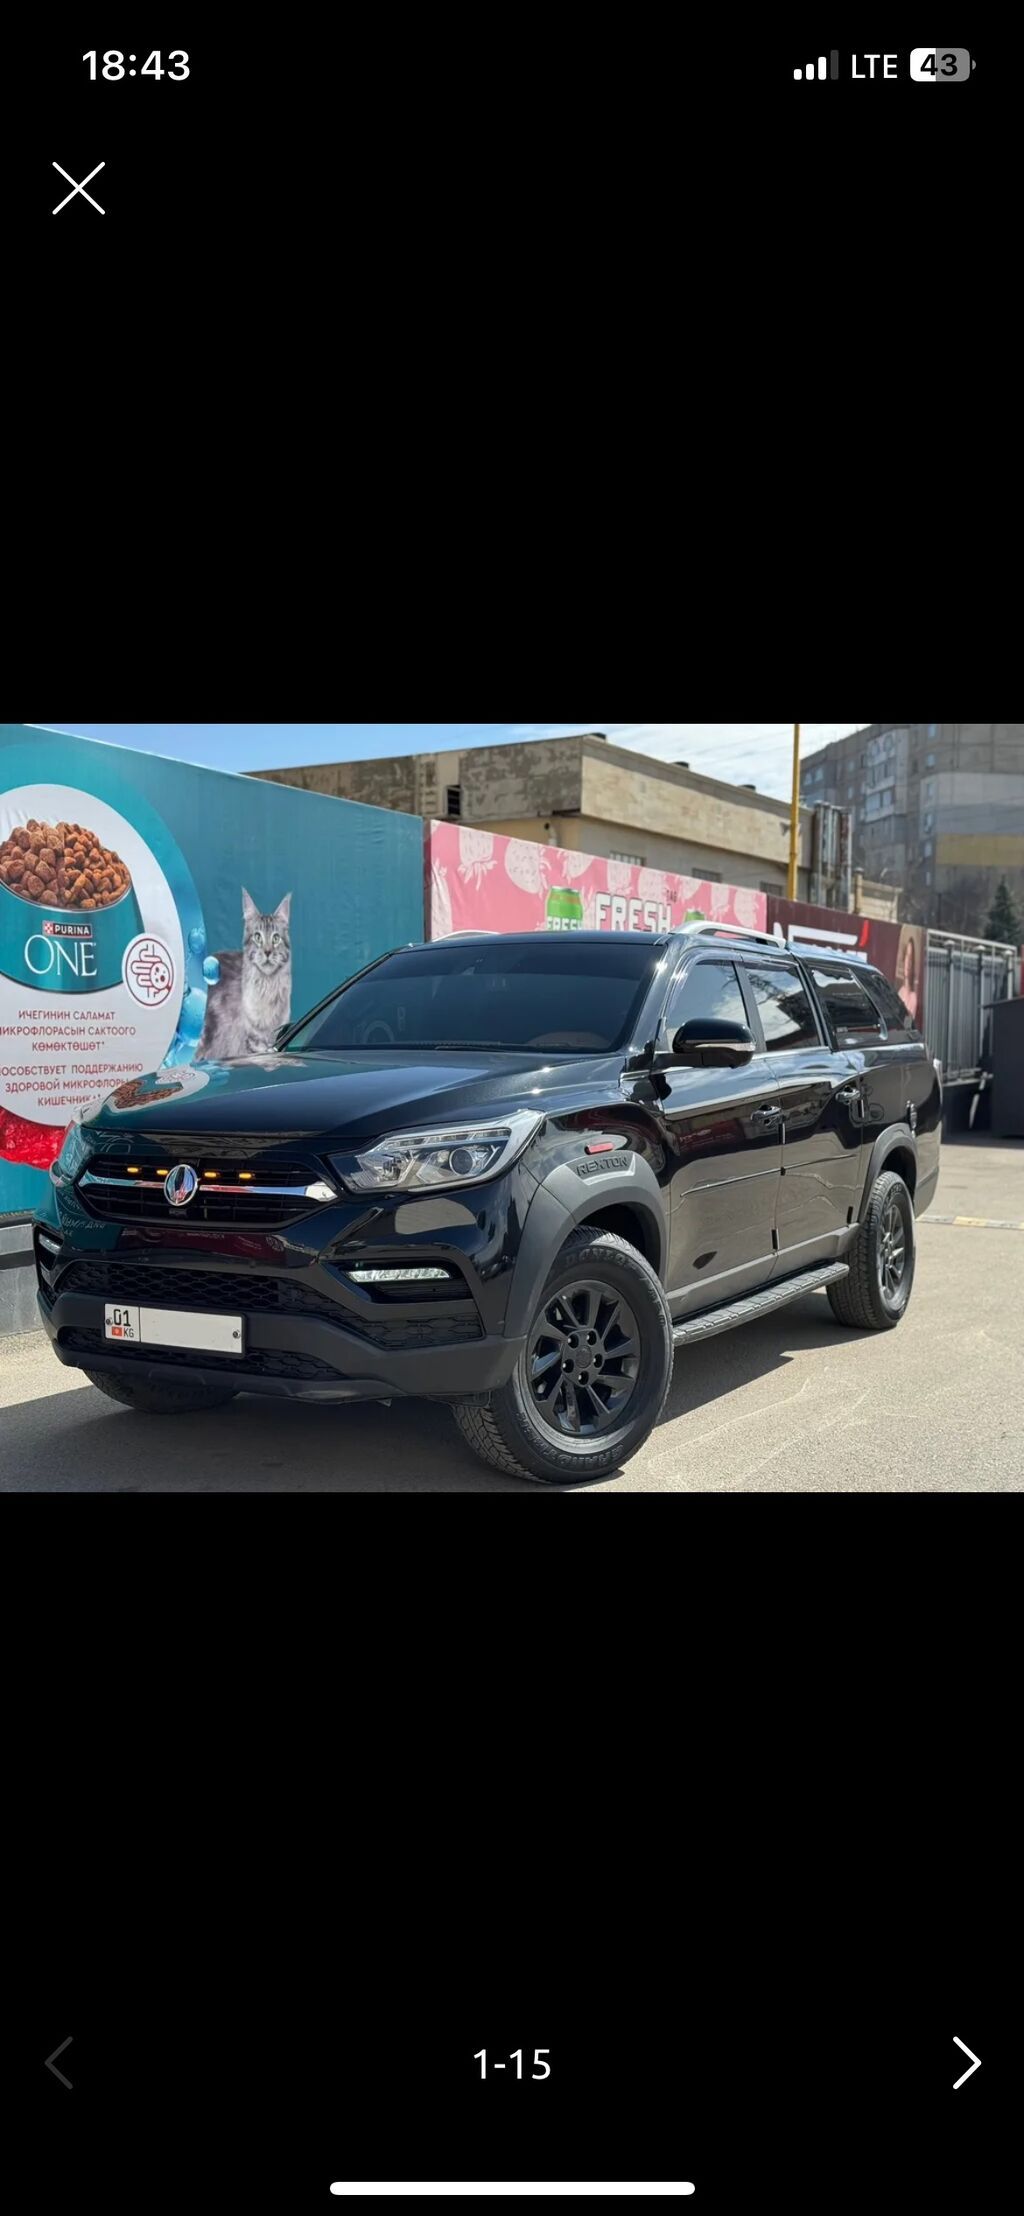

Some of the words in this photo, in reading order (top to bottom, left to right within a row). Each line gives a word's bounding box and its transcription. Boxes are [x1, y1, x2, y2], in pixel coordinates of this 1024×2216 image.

[596, 891, 671, 932] FRESH
[54, 924, 90, 935] PURINA
[24, 934, 97, 977] ONE
[18, 1010, 70, 1020] ИЧЕГИНИН
[73, 1011, 115, 1021] САЛАМАТ
[0, 1026, 85, 1036] ИКРОФЛОРАСЫН
[88, 1026, 136, 1036] САКТООГО
[0, 1065, 66, 1076] ОСОБСТВУЕТ
[71, 1063, 143, 1074] ПОДДЕРЖАНИЮ
[5, 1079, 60, 1093] ЗДОРОВОЙ
[576, 1156, 628, 1176] REXTON
[113, 1308, 131, 1326] 01
[123, 1328, 134, 1337] KG
